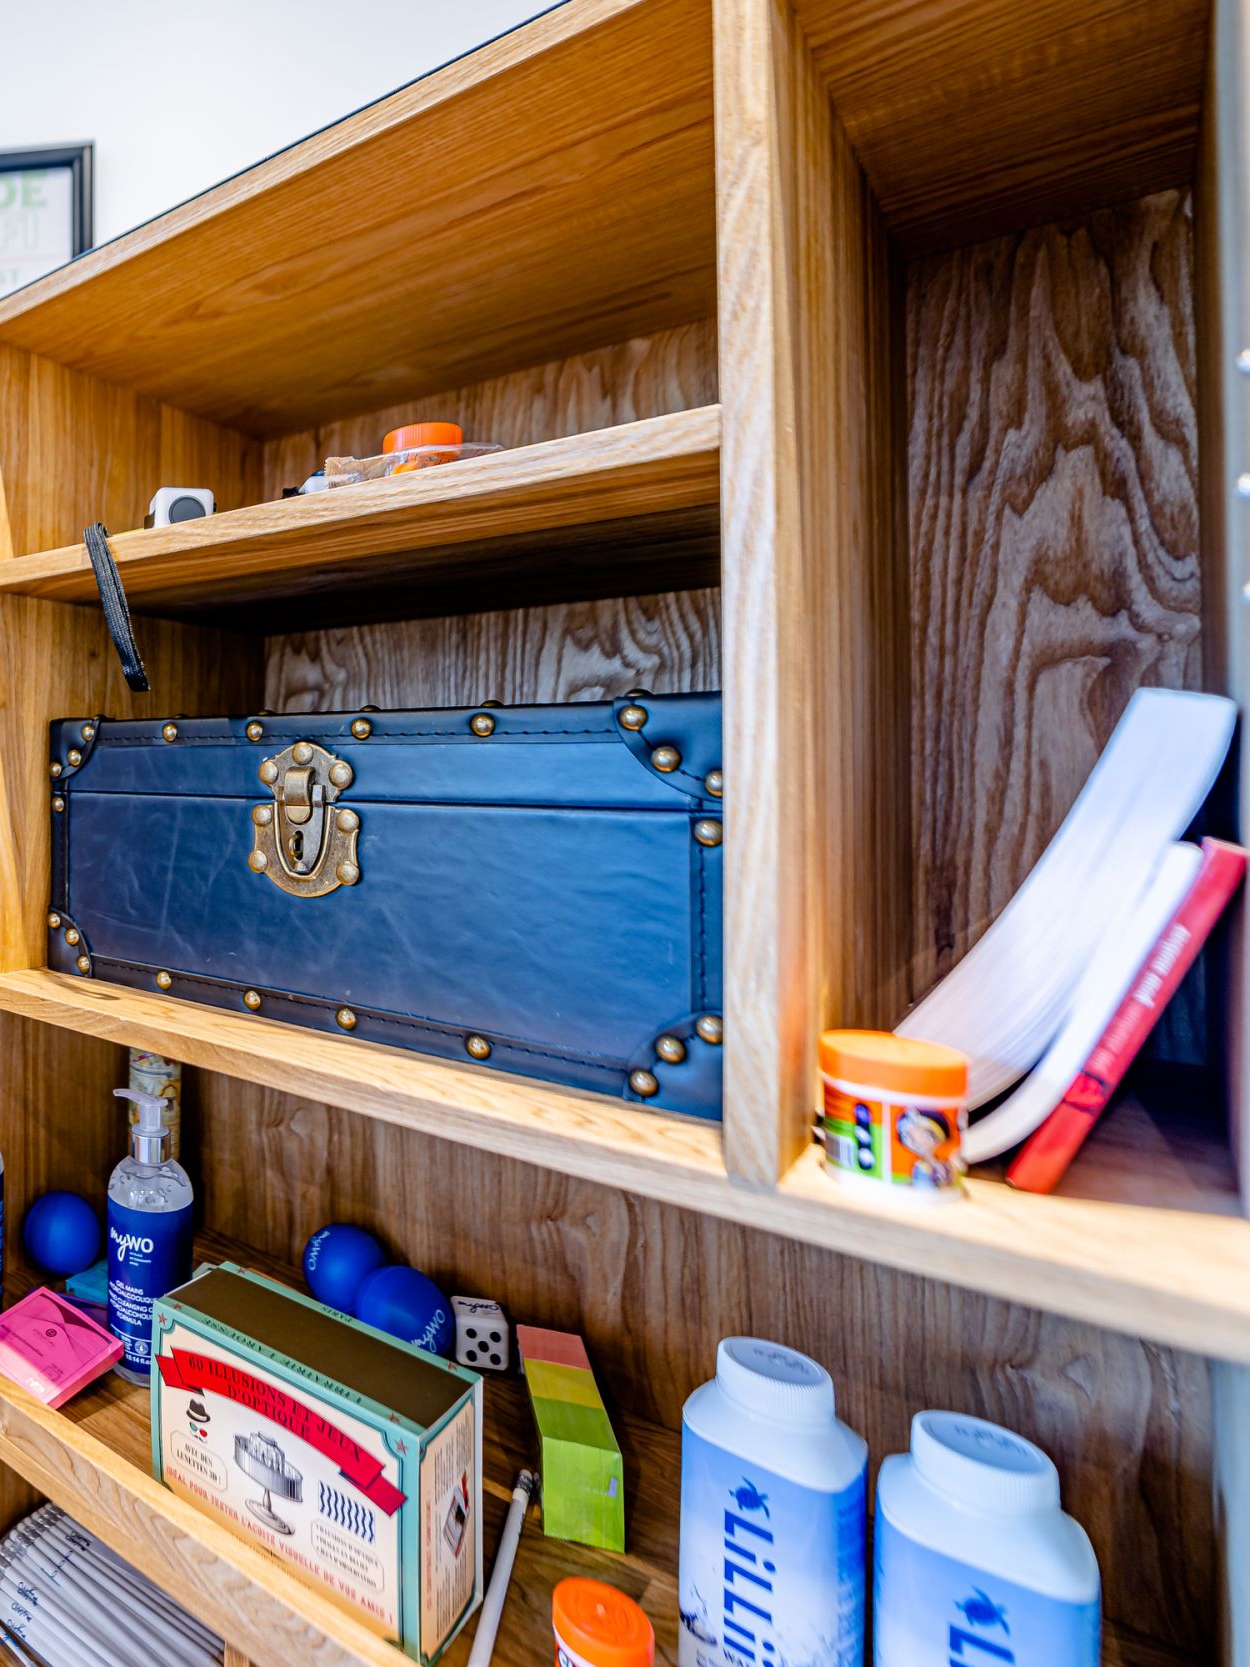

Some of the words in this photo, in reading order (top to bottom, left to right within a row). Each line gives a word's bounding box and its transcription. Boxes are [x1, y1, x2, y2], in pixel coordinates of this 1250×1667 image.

[189, 1355, 204, 1373] 60
[209, 1361, 286, 1407] ILLUSIONS
[293, 1399, 313, 1423] ET
[316, 1419, 362, 1462] JEUX
[228, 1384, 311, 1441] D'OPTIQUE
